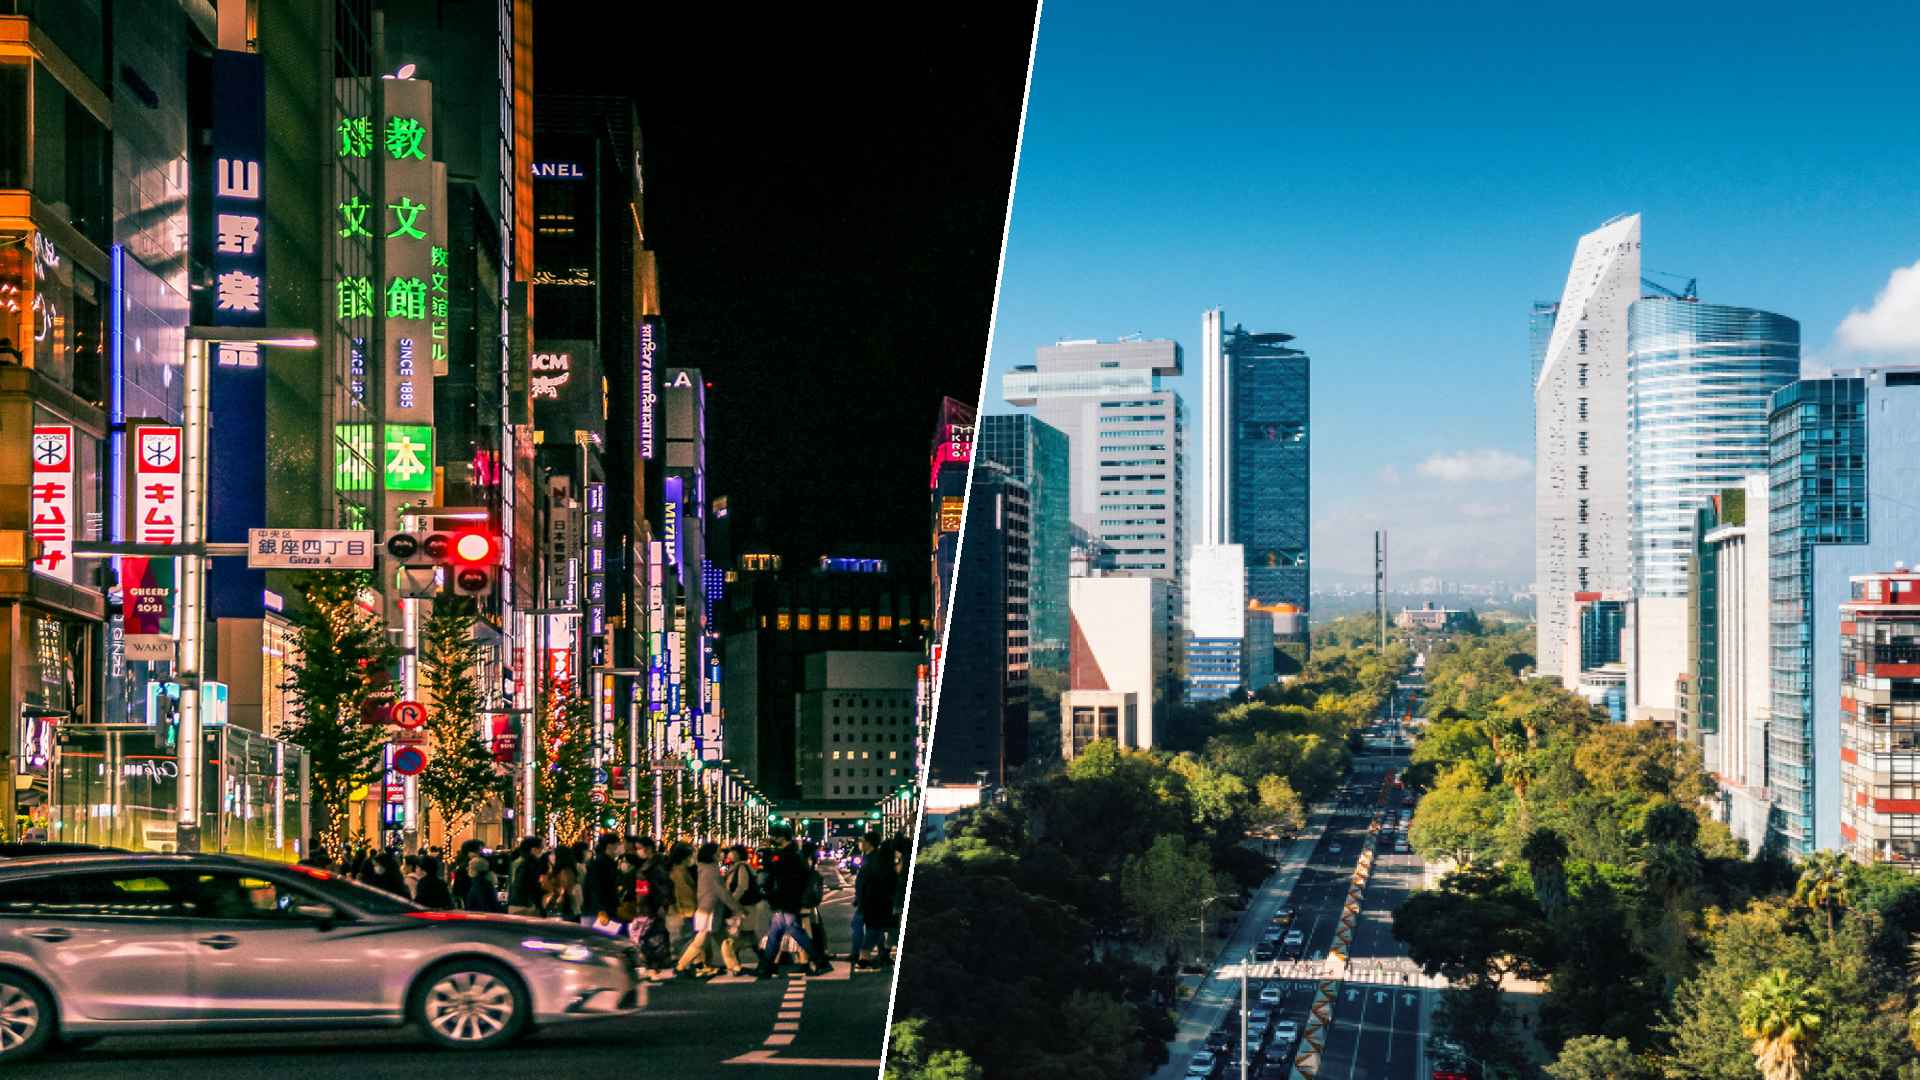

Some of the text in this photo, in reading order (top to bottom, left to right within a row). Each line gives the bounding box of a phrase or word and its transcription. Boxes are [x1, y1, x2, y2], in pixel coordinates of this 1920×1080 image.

[385, 115, 427, 319] 教文館
[431, 246, 448, 361] 教文館ビル
[400, 338, 413, 408] SINCE 1885
[387, 436, 425, 480] 本
[258, 530, 290, 538] 中央区
[258, 540, 364, 556] 銀座四丁目
[289, 556, 320, 564] Ginza
[130, 588, 169, 596] CHEERS
[137, 604, 162, 612] 2021
[134, 643, 168, 652] WAKO
